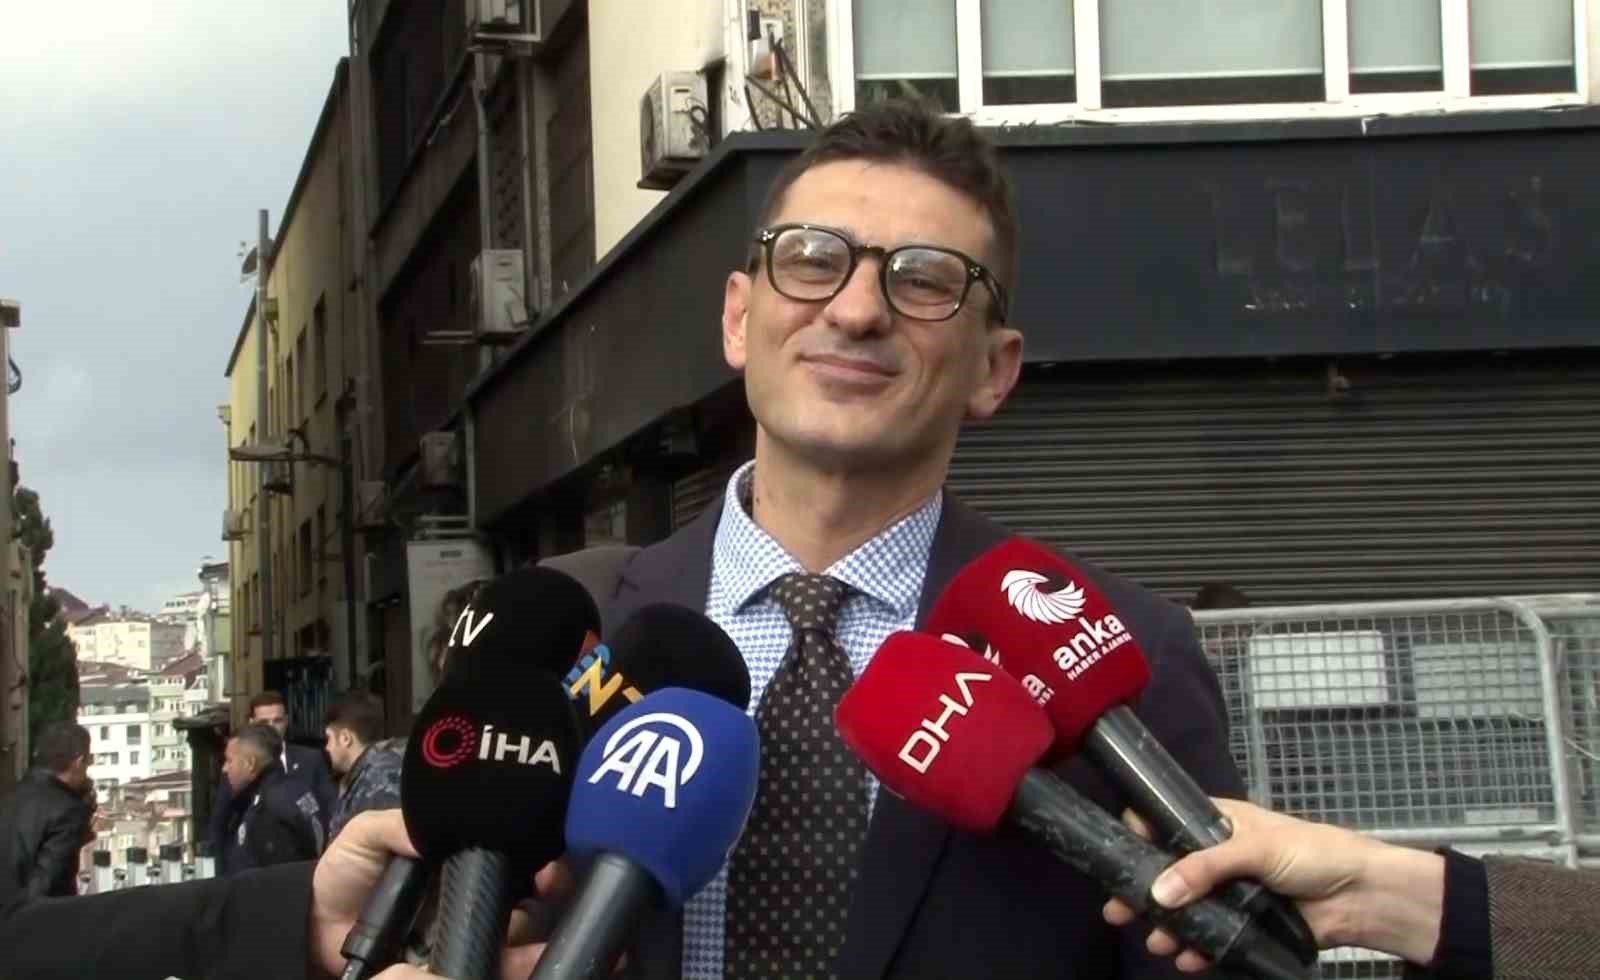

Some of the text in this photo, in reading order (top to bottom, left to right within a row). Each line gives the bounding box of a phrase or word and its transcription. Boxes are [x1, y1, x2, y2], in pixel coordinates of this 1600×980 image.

[1053, 614, 1126, 671] anka
[1066, 651, 1102, 681] HABER
[478, 724, 561, 775] İHA
[898, 672, 992, 774] DHA
[588, 730, 681, 809] AA
